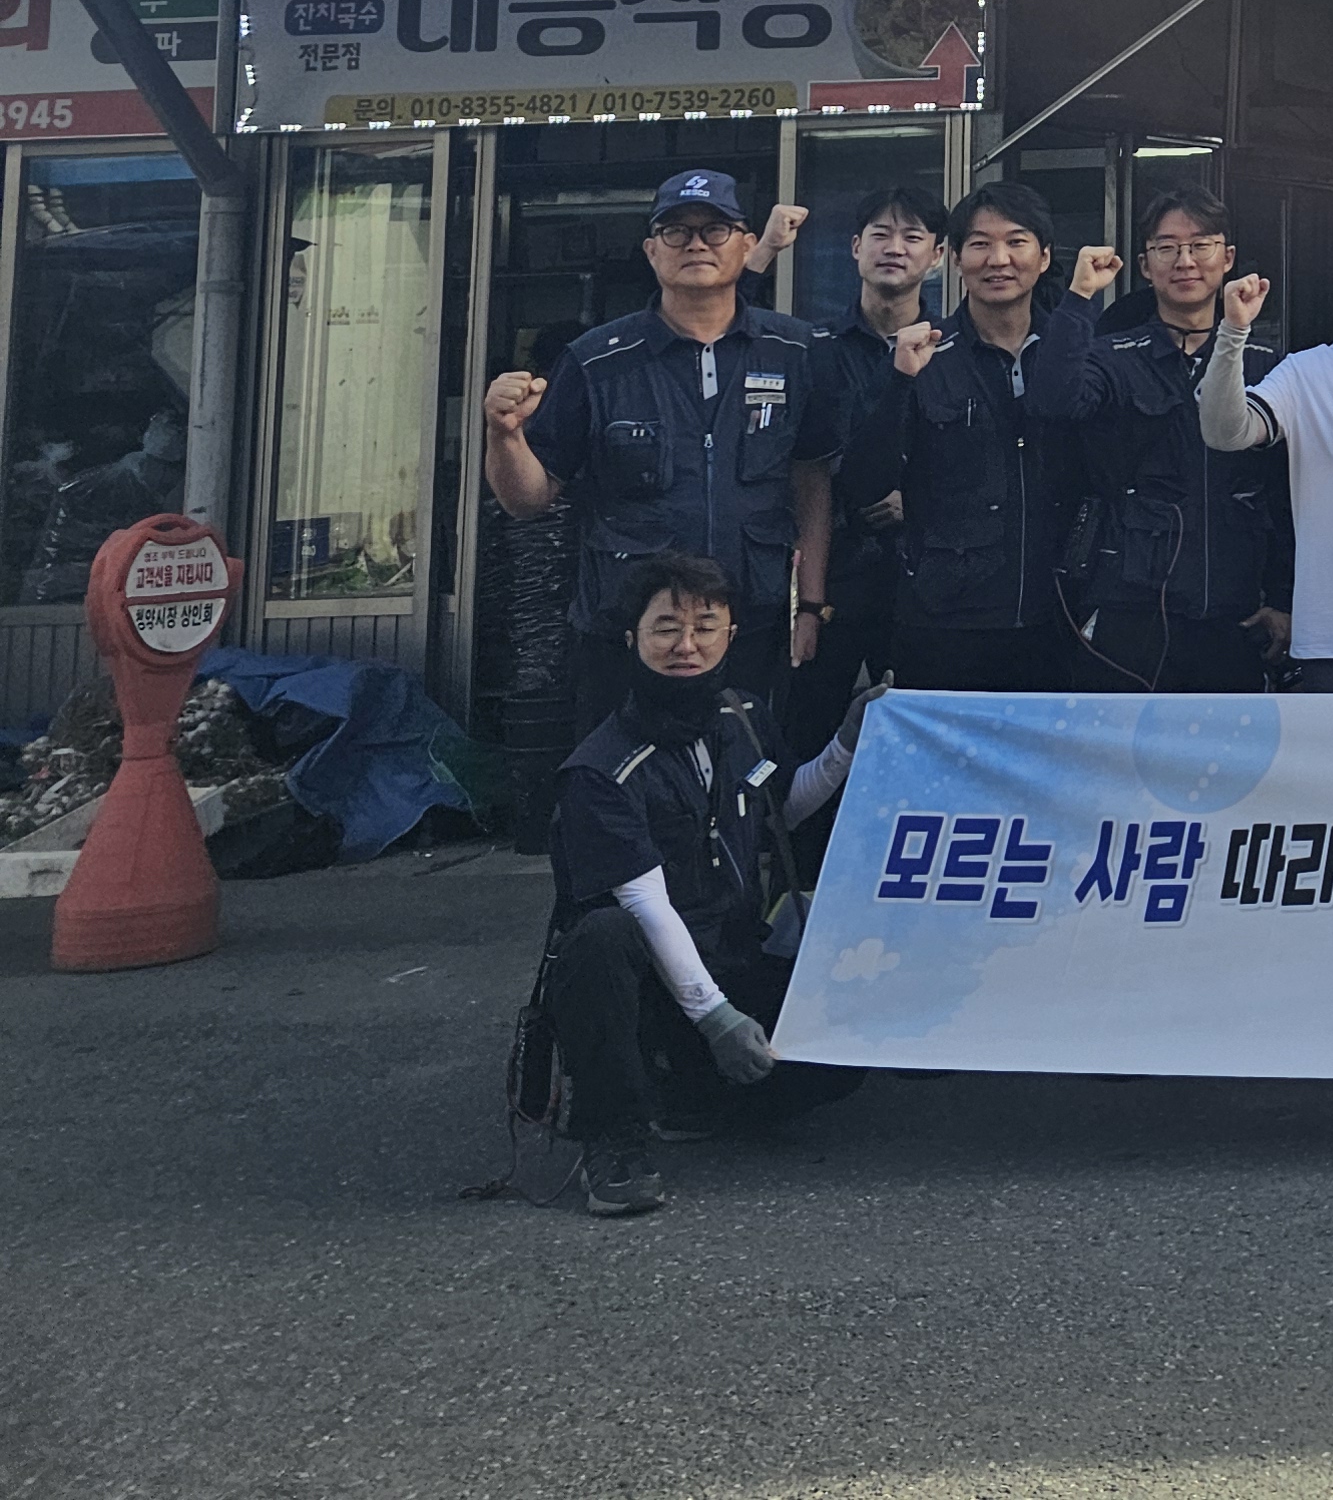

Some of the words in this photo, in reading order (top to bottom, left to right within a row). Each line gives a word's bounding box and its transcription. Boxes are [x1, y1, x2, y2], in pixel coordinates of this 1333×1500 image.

[294, 1, 378, 31] 잔치국수
[299, 42, 361, 72] 전문점
[410, 92, 578, 118] 010-8355-4821
[603, 87, 775, 112] 010-7539-2260
[136, 564, 173, 589] 고객선을
[175, 562, 213, 586] 지킵시다
[180, 602, 214, 628] 상인회
[877, 815, 1054, 919] 모르는
[1074, 820, 1206, 923] 사람
